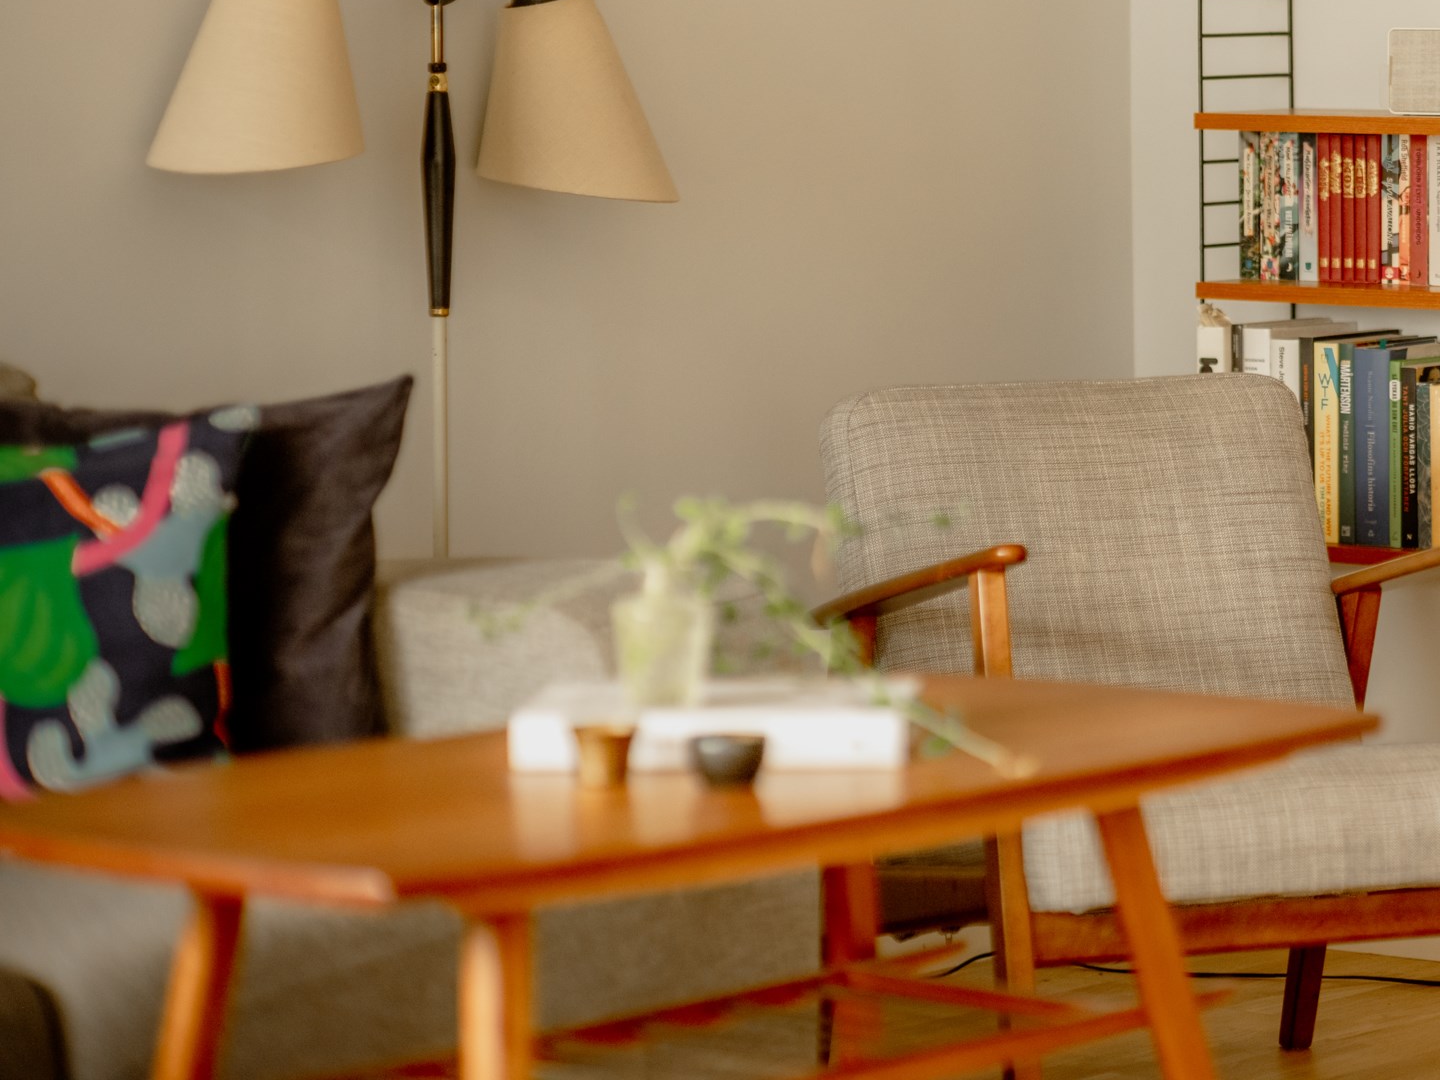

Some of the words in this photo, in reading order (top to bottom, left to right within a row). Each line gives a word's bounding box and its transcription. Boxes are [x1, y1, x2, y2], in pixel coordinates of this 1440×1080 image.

[1340, 364, 1354, 414] MÅRTENSON
[1391, 381, 1399, 400] LYCKAS
[1408, 404, 1416, 431] MARIO
[1319, 447, 1325, 457] UP
[1366, 431, 1376, 476] Filosofins
[1408, 433, 1416, 465] VARGAS
[1319, 459, 1325, 472] TO
[1342, 455, 1350, 474] ring
[1319, 473, 1325, 484] US
[1408, 468, 1416, 495] LLOSA
[1366, 477, 1376, 512] historia
